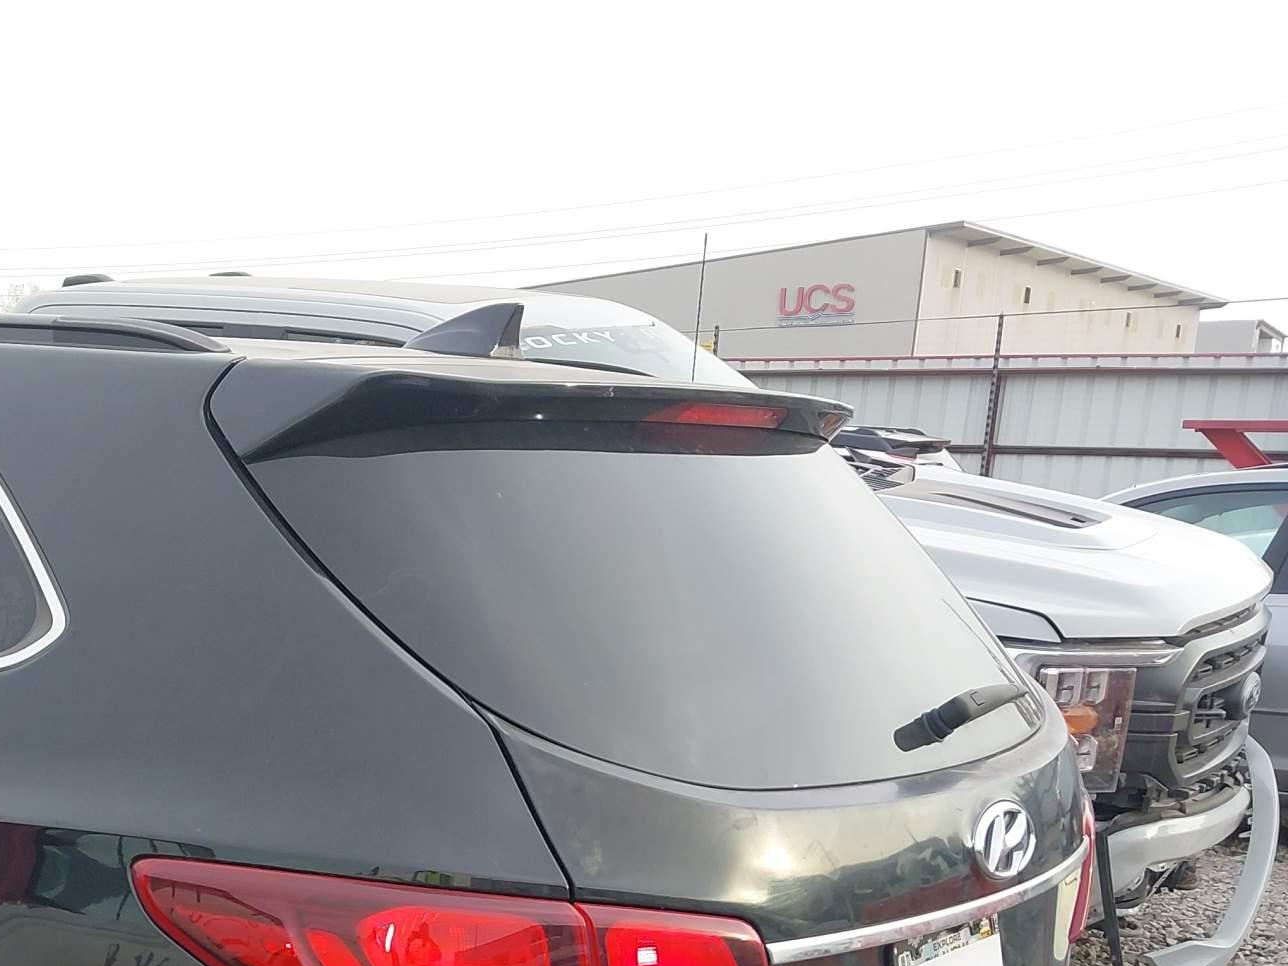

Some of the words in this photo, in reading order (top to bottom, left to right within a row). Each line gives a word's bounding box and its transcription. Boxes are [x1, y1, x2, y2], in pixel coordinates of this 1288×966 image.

[778, 283, 855, 316] UCS
[520, 330, 615, 351] OCKY
[932, 932, 962, 952] EXPLORE
